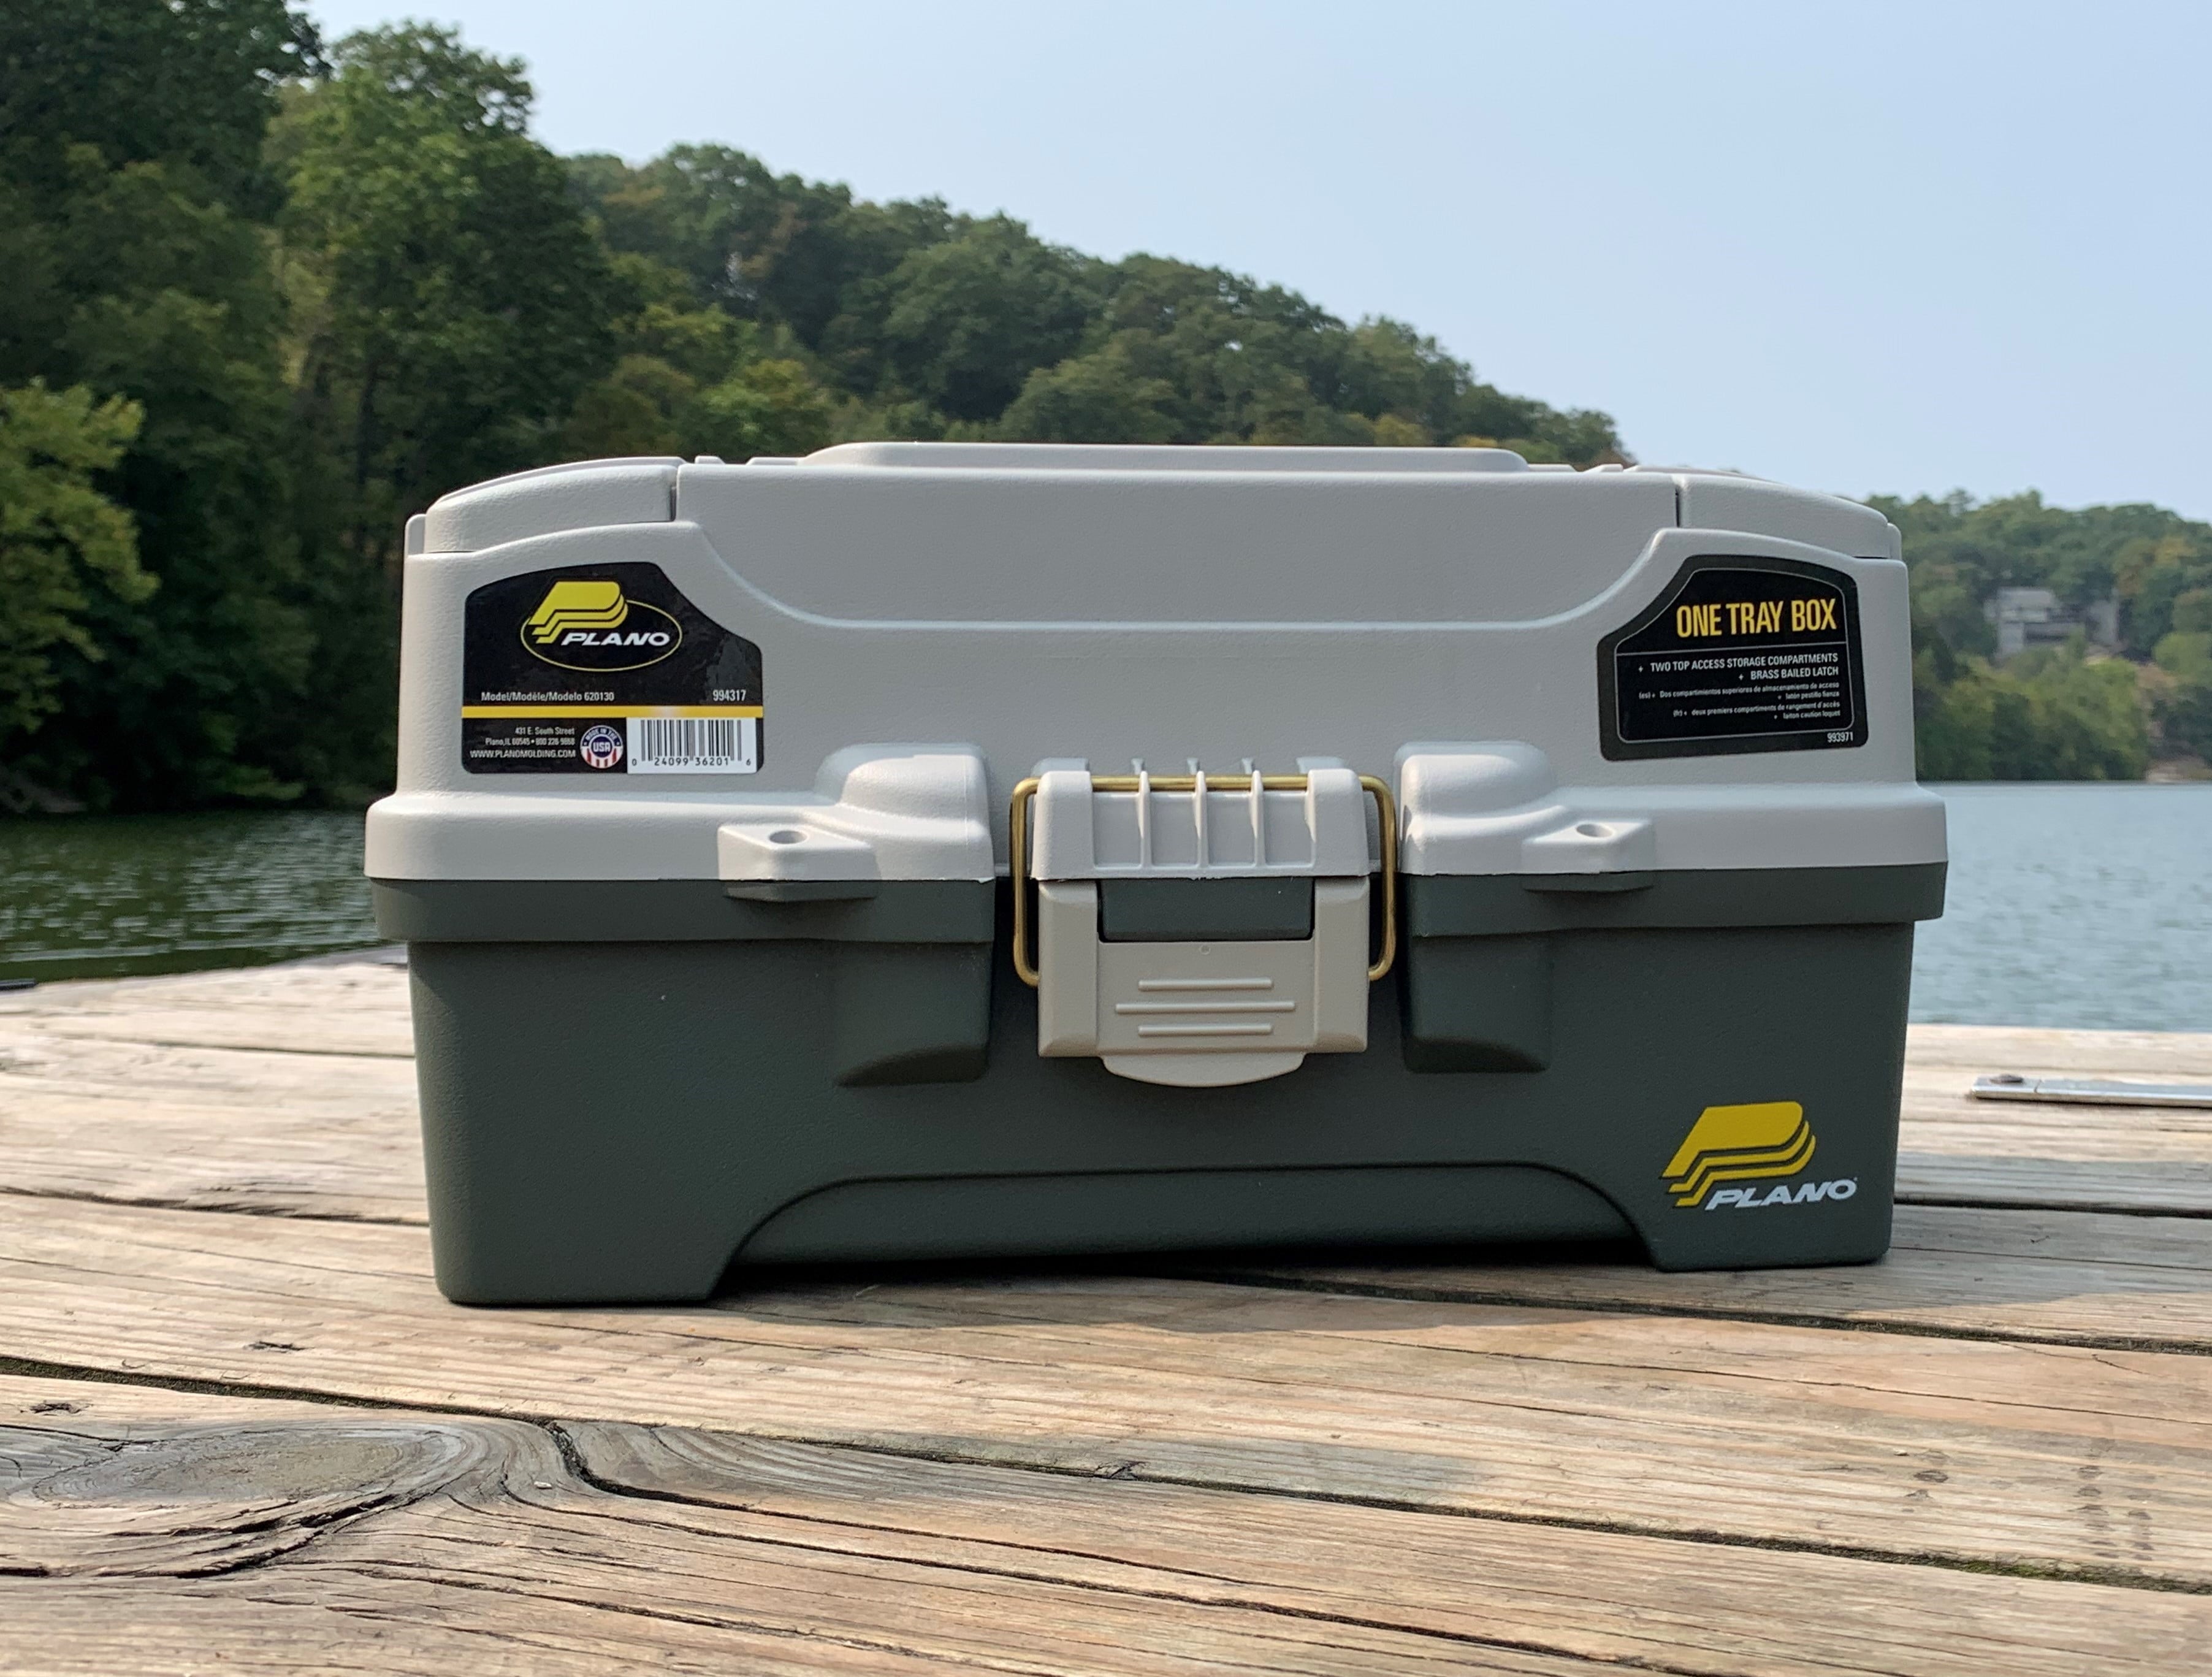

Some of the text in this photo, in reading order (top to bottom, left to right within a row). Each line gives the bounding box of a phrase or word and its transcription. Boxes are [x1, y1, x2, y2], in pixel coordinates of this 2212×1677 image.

[1677, 598, 1837, 638] ONE TRAY BOX
[560, 632, 670, 646] PLANO
[1650, 653, 1839, 672] TWO TOP ACCESS STORAGE COMPARTMENTS
[1750, 667, 1839, 680] BRASS BAILED LATCH
[584, 692, 614, 701] 620130
[712, 689, 747, 701] 994317
[535, 727, 554, 735] South
[555, 727, 575, 735] Street
[1826, 732, 1854, 743] 993971
[593, 741, 611, 752] USA
[470, 749, 576, 758] WWW.PLANOMOLDING.COM
[654, 757, 689, 766] 24099
[695, 757, 729, 766] 36201
[1704, 1178, 1858, 1211] PLANO
